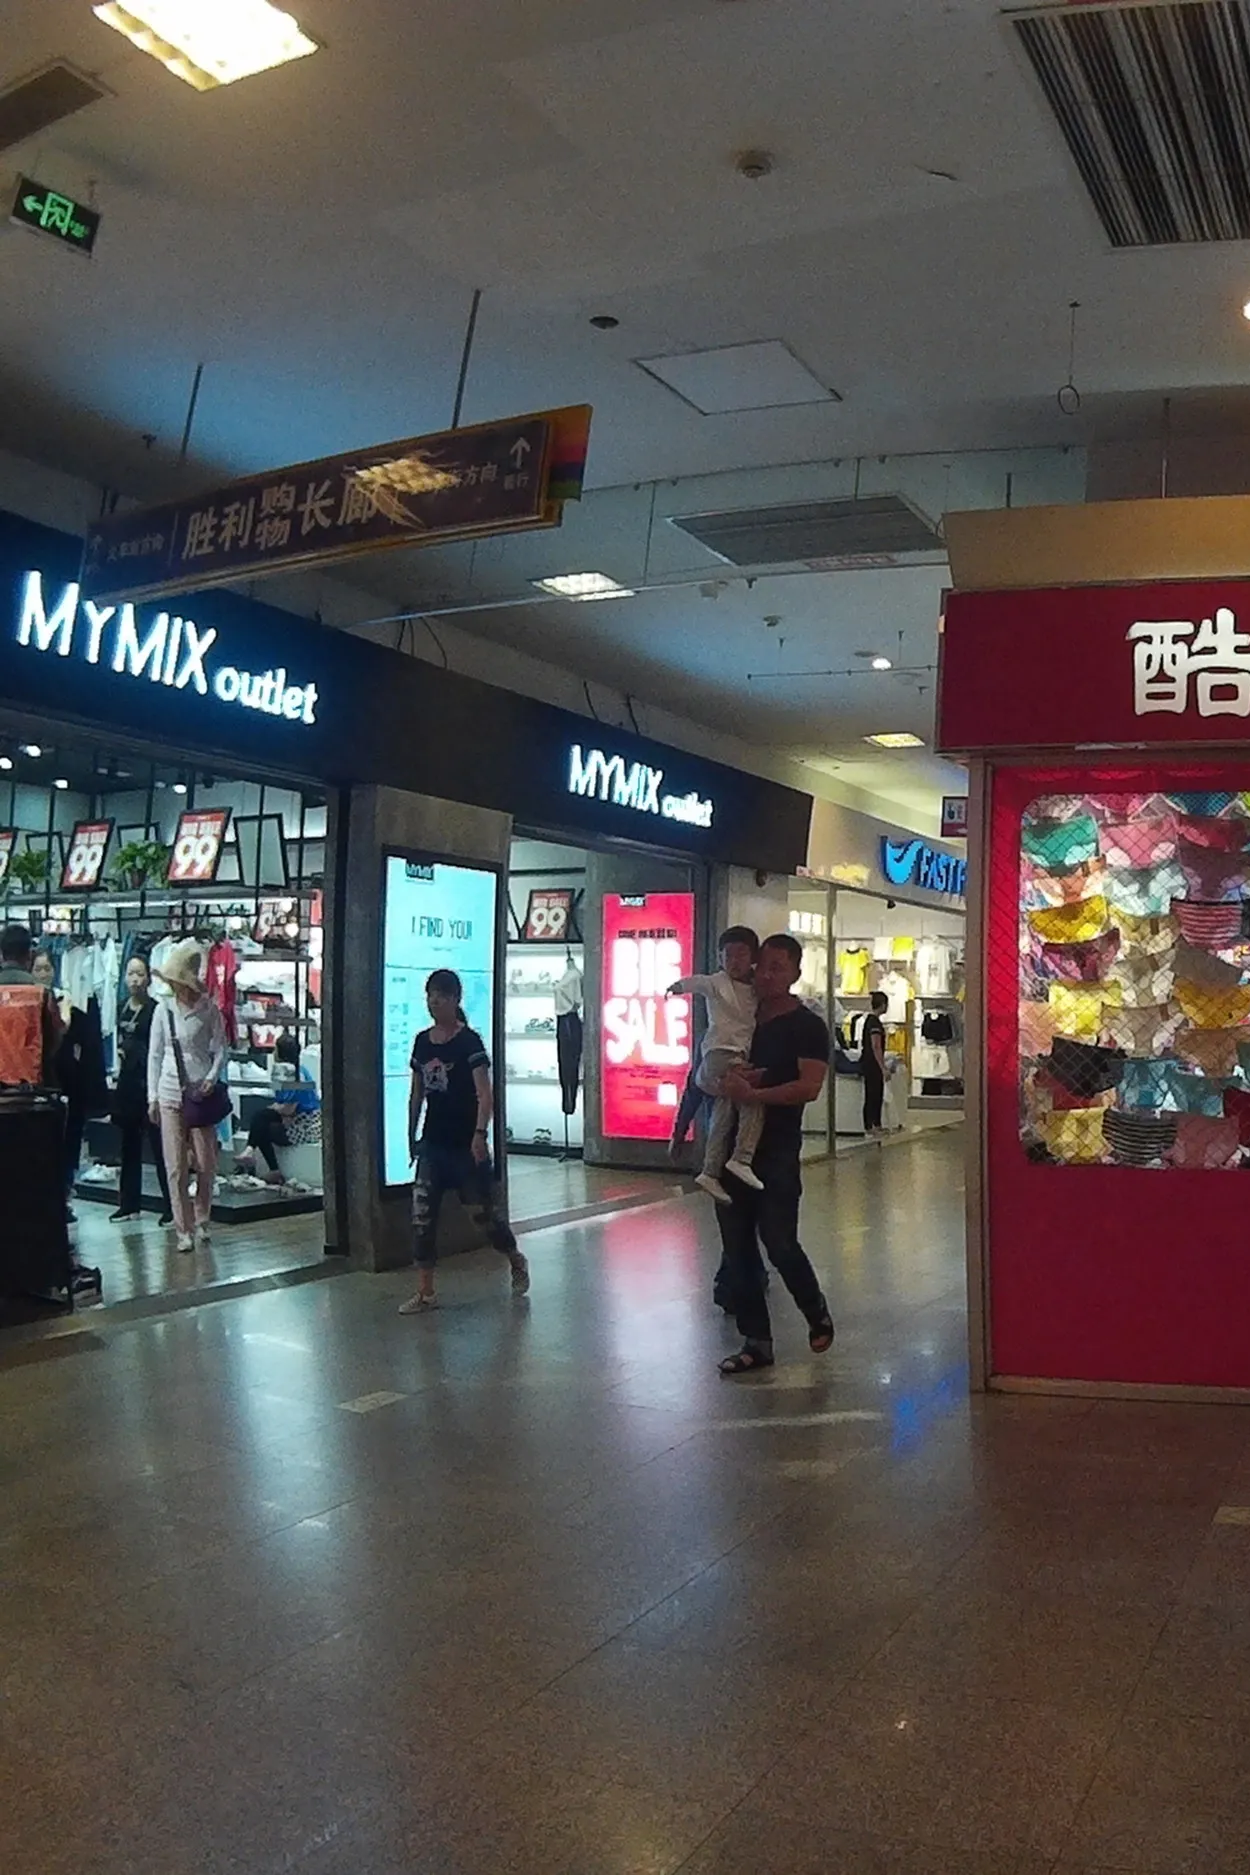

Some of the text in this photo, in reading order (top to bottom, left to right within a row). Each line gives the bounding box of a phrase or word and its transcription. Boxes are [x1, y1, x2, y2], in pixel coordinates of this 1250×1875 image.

[17, 569, 319, 725] MYMIX outlet
[569, 743, 663, 815] MYMIX
[68, 843, 106, 884] 99
[173, 834, 220, 878] 99
[531, 907, 567, 937] 99
[613, 938, 682, 997] BIG
[603, 997, 690, 1065] SALE
